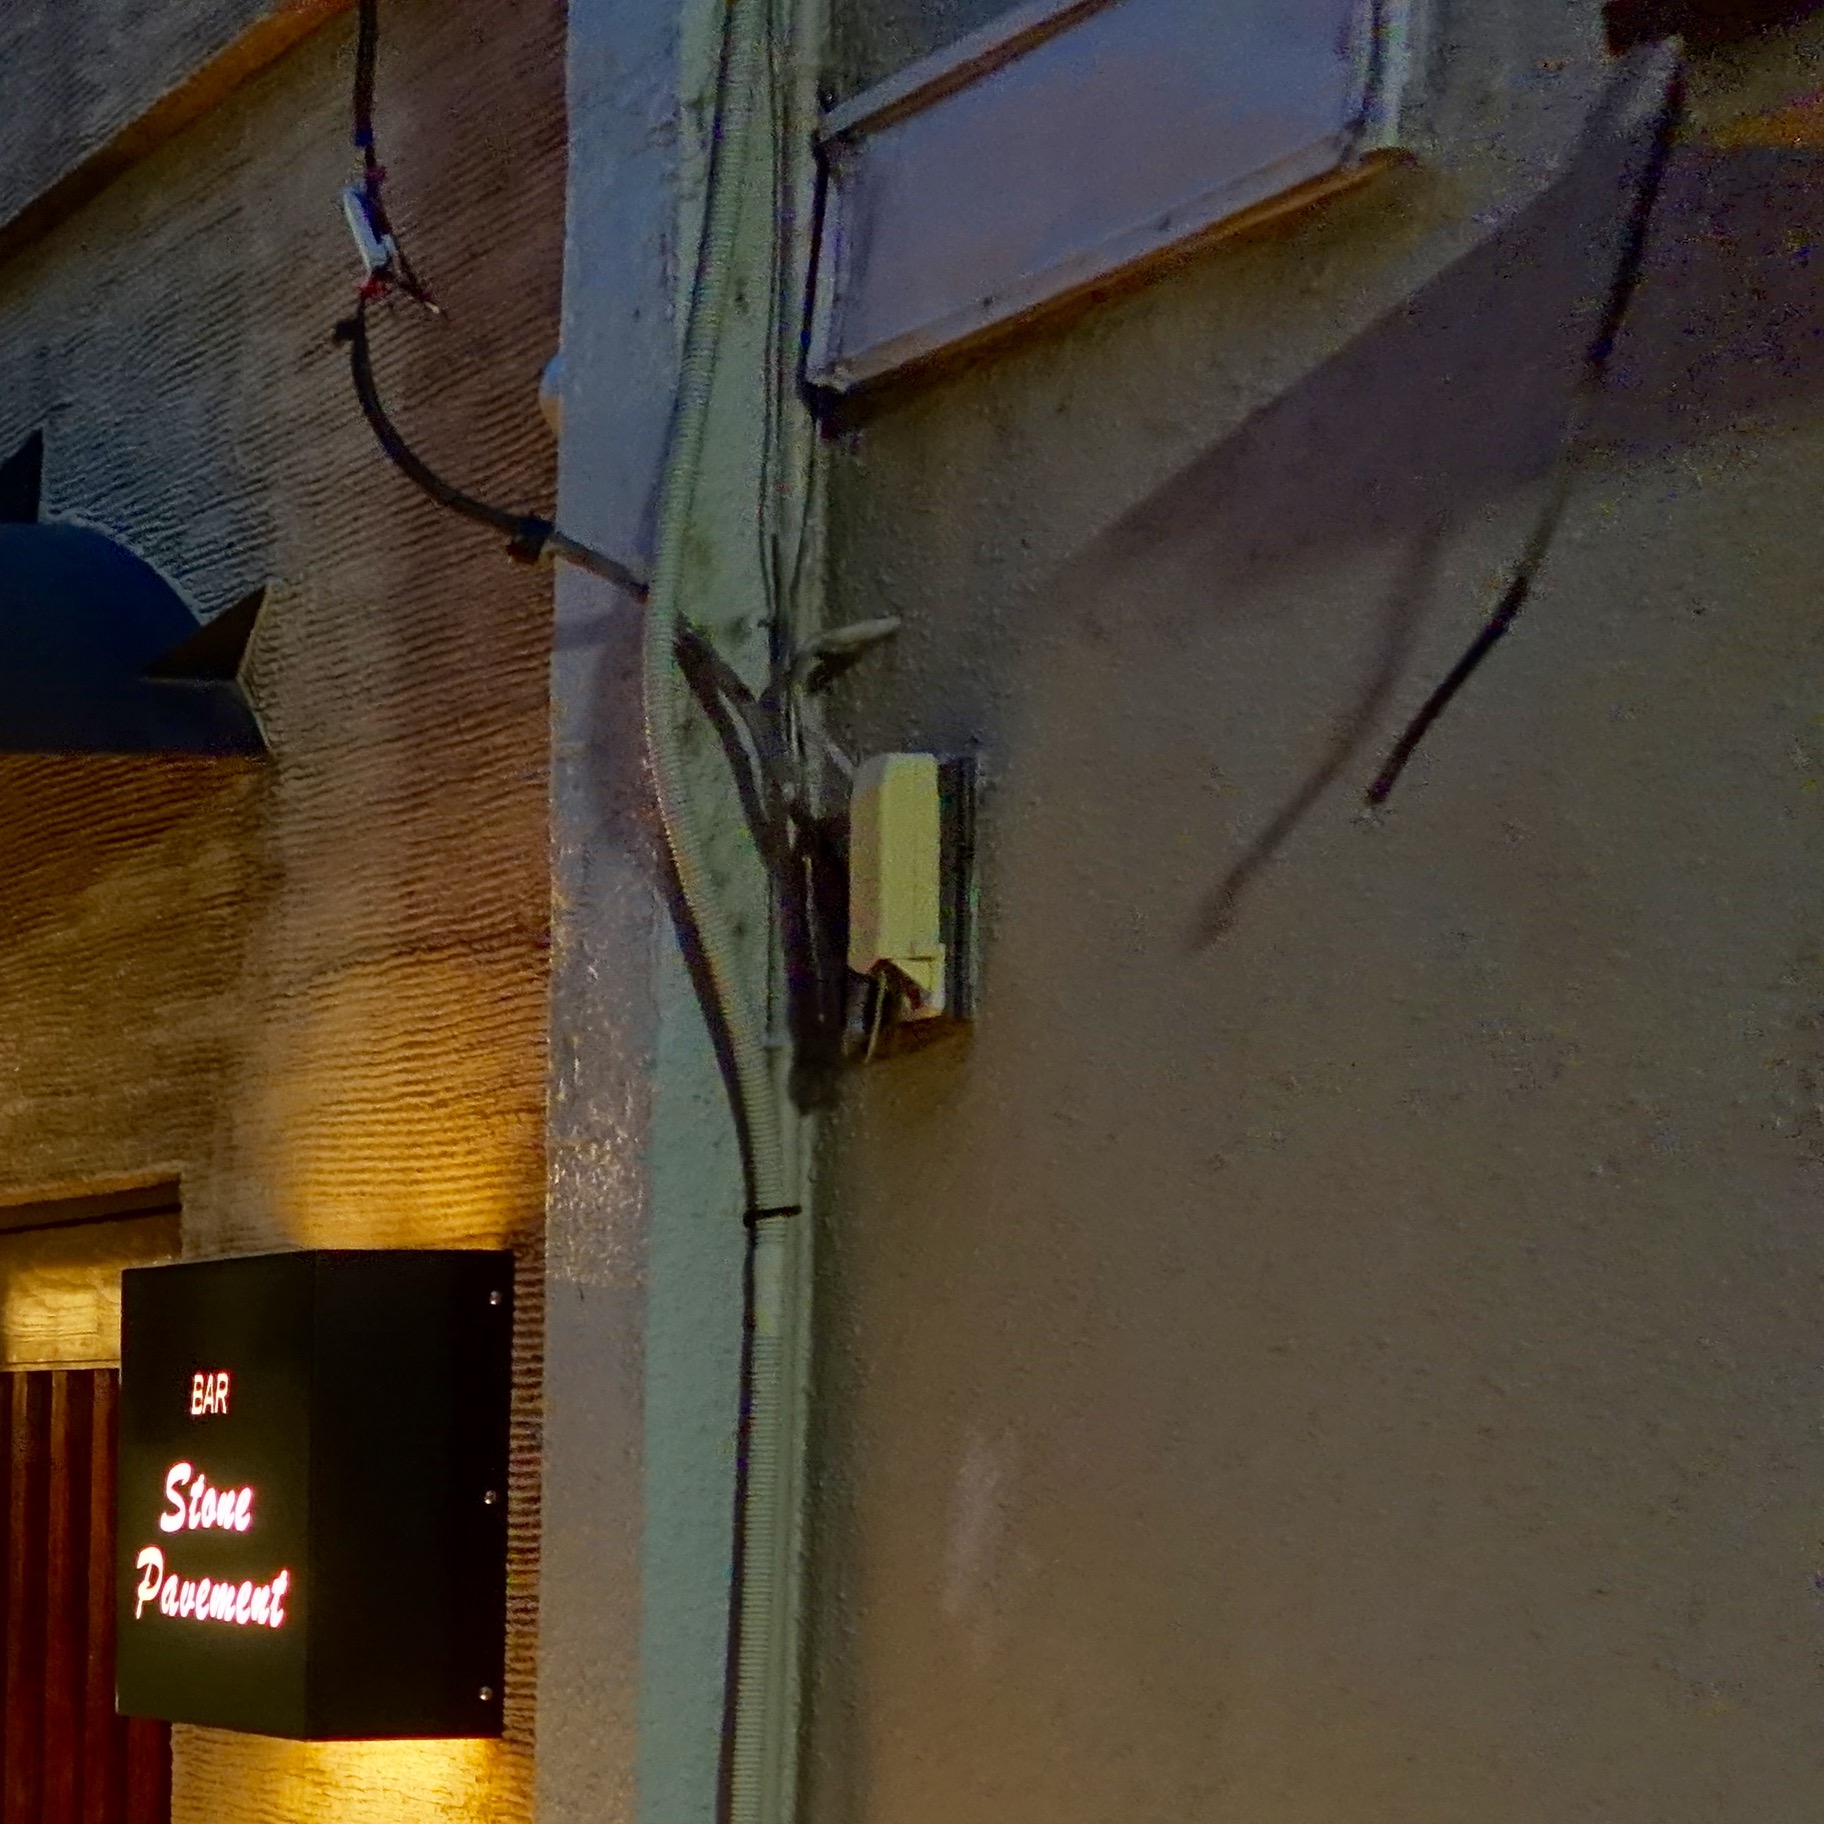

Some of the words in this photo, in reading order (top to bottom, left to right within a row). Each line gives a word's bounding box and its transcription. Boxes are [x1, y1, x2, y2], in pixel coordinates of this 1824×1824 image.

[189, 1371, 231, 1417] BAR
[159, 1460, 255, 1534] Stone
[134, 1544, 292, 1630] Pavement
